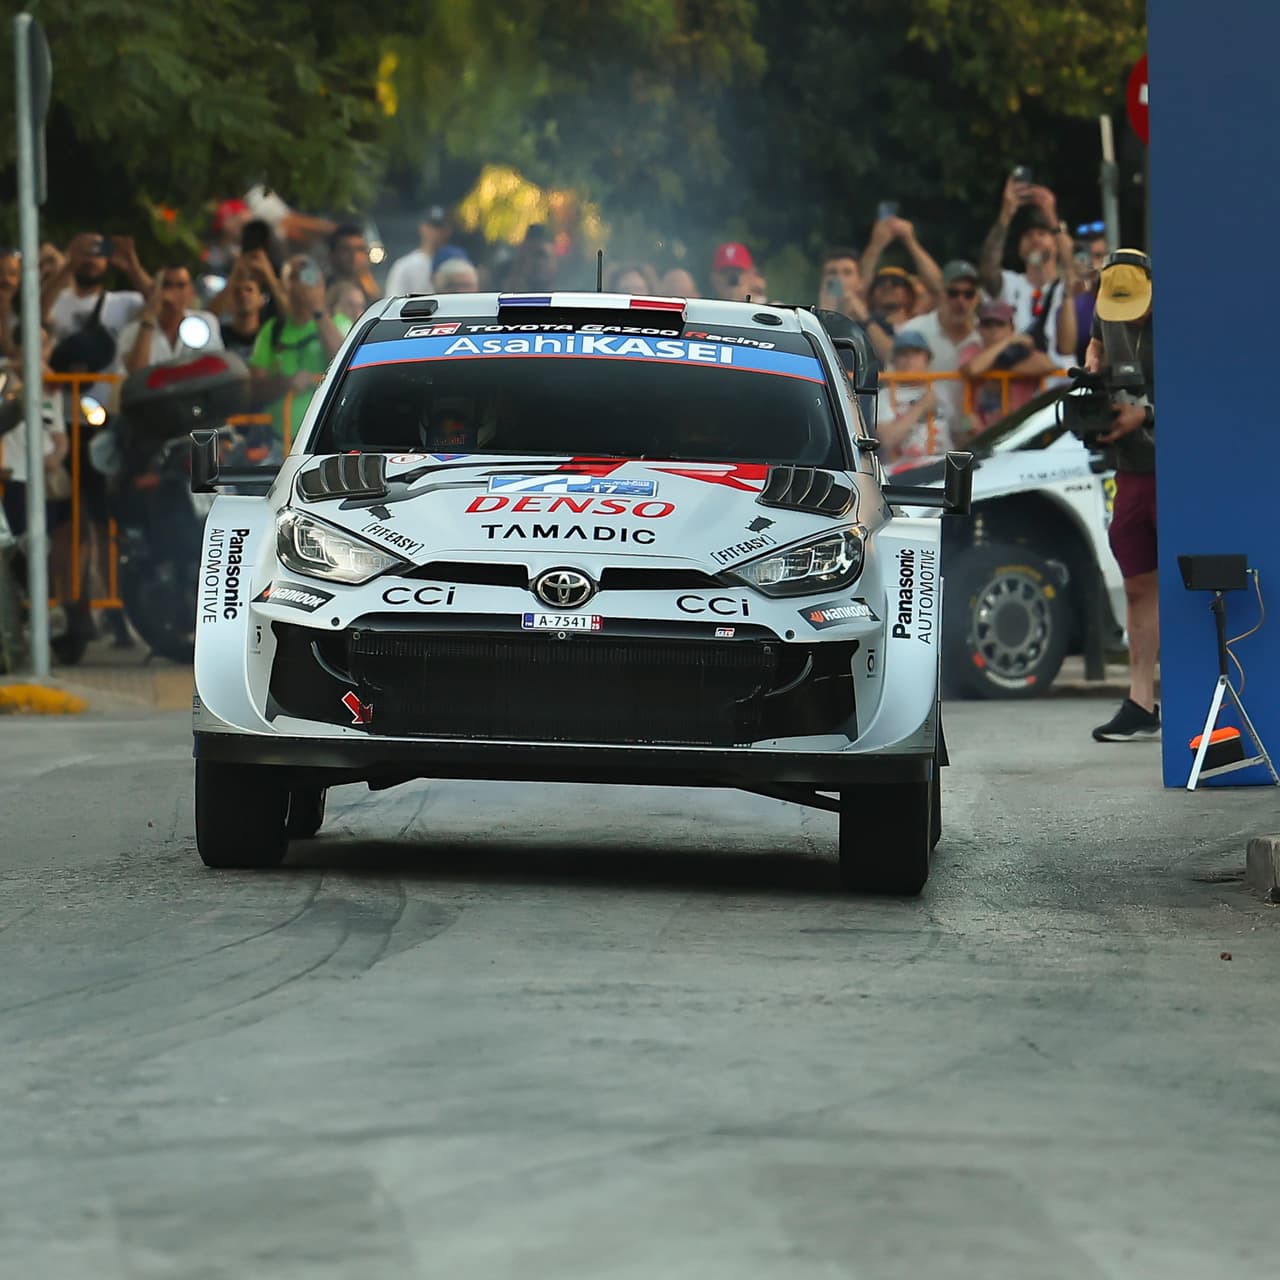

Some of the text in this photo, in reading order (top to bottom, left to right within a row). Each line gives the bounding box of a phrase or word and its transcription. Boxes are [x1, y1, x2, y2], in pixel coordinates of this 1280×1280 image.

[443, 335, 734, 364] AsahiKASEI
[465, 324, 572, 334] TOYOTA
[683, 330, 776, 349] Racing
[591, 484, 618, 494] 17
[465, 495, 676, 519] DENSO
[481, 524, 657, 545] TAMADIC
[203, 528, 225, 624] AUTOMOTIVE
[223, 528, 250, 621] Panasonic
[892, 548, 915, 640] Panasonic
[918, 549, 936, 645] AUTOMOTIVE
[538, 615, 587, 628] A-7541
